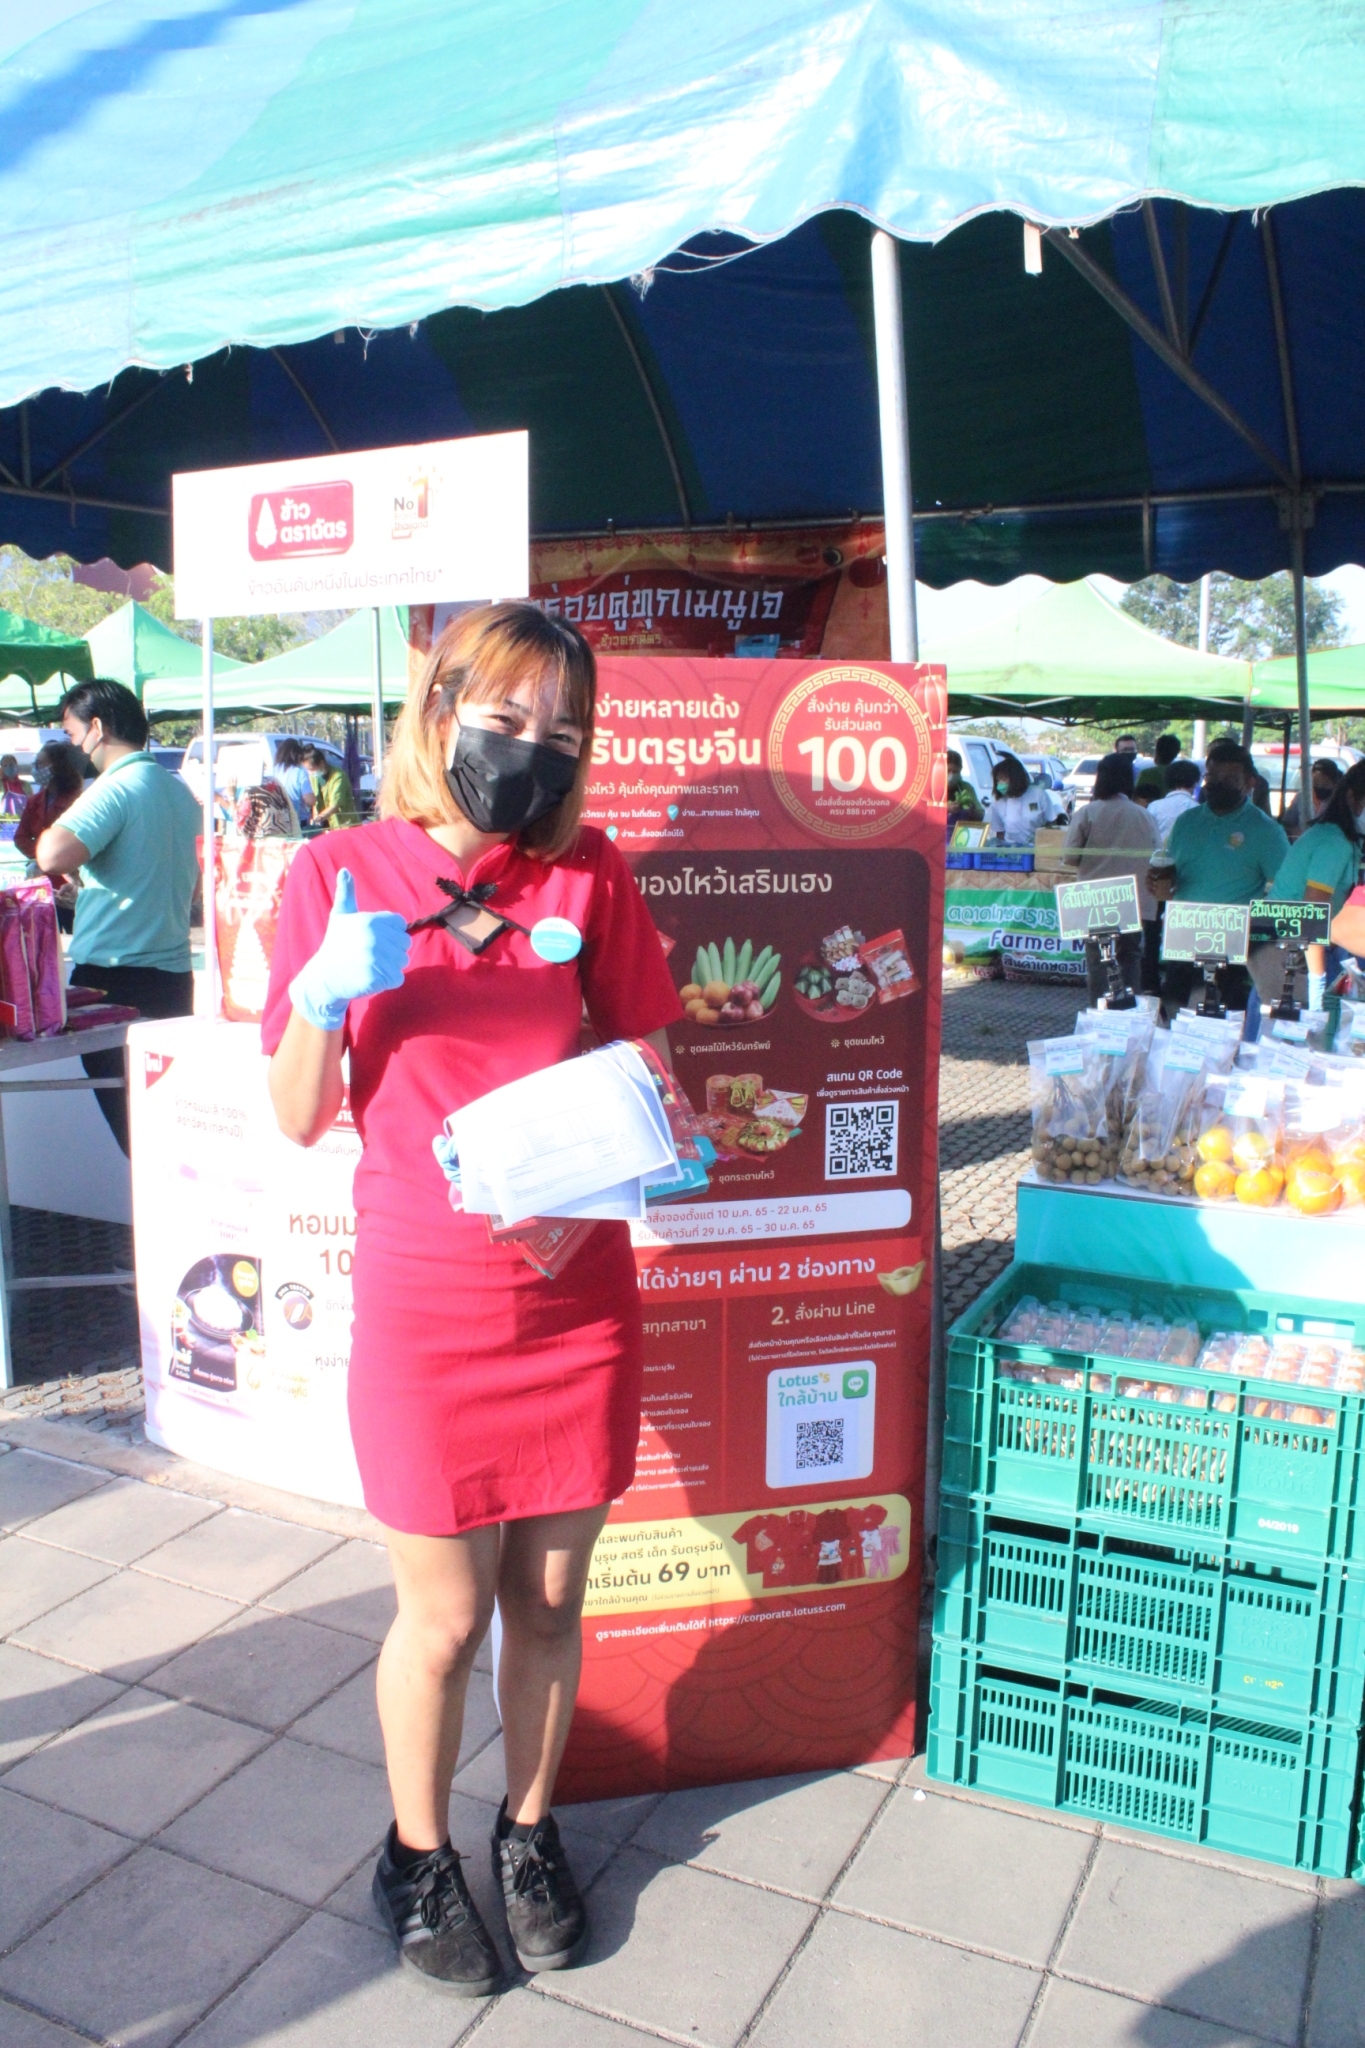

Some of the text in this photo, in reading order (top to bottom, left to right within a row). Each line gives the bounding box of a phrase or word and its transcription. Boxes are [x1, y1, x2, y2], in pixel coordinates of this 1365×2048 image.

[280, 497, 311, 522] ข้าว
[280, 518, 347, 544] ตราฉัตร
[595, 692, 741, 719] ง่ายหลายเด้ง
[807, 694, 899, 718] สั่งง่าย คุ้มกว่า
[824, 716, 882, 731] รับส่วนลด
[590, 727, 763, 777] รับตรุษจีน
[797, 735, 908, 793] 100
[618, 779, 740, 798] คุ้มทั้งคุณภาพและราคา
[846, 808, 860, 816] 888
[861, 808, 876, 816] บาท
[1088, 906, 1121, 928] 45
[1193, 931, 1226, 955] 59
[1003, 954, 1087, 974] สินค้าเกษตรป
[690, 1040, 771, 1054] ชุดผลไม้ไหว้รับทรัพย์
[844, 1035, 885, 1048] ชุดขนมไหว้
[826, 1067, 903, 1083] สแกน QR Code
[221, 1106, 248, 1122] 100%
[719, 1169, 775, 1184] ชุดกระดาษไหว้
[717, 1210, 729, 1219] 10
[732, 1209, 752, 1218] ม.ค.
[755, 1206, 768, 1216] 65
[777, 1205, 790, 1215] 22
[792, 1204, 812, 1214] ม.ค.
[815, 1202, 827, 1212] 65
[637, 1224, 700, 1241] รับสินค้าวันที่
[702, 1226, 715, 1237] 29
[718, 1226, 738, 1236] ม.ค.
[740, 1224, 753, 1234] 65
[764, 1222, 777, 1233] 30
[779, 1221, 800, 1232] ม.ค.
[802, 1219, 815, 1229] 65
[637, 1255, 876, 1290] ได้ง่ายๆ ผ่าน 2 ช่องทาง
[771, 1301, 875, 1326] 2. สั่งผ่าน Line
[778, 1371, 831, 1388] Lotus's
[640, 1391, 693, 1403] อมใบเสร็จรับเงิน
[777, 1387, 838, 1408] ใกล้บ้าน
[598, 1529, 683, 1545] และพบกับสินค้า
[594, 1540, 723, 1565] บุรุษ สตรี เด็ก รับตรุษจีน
[586, 1560, 731, 1590] าเริ่มต้น 69 บาท
[584, 1592, 648, 1606] าขาใกล้บ้านคุณ
[595, 1602, 846, 1643] ดูรายละเอียดเพิ่มเติมได้ที่ https://corporate.lotuss.com
